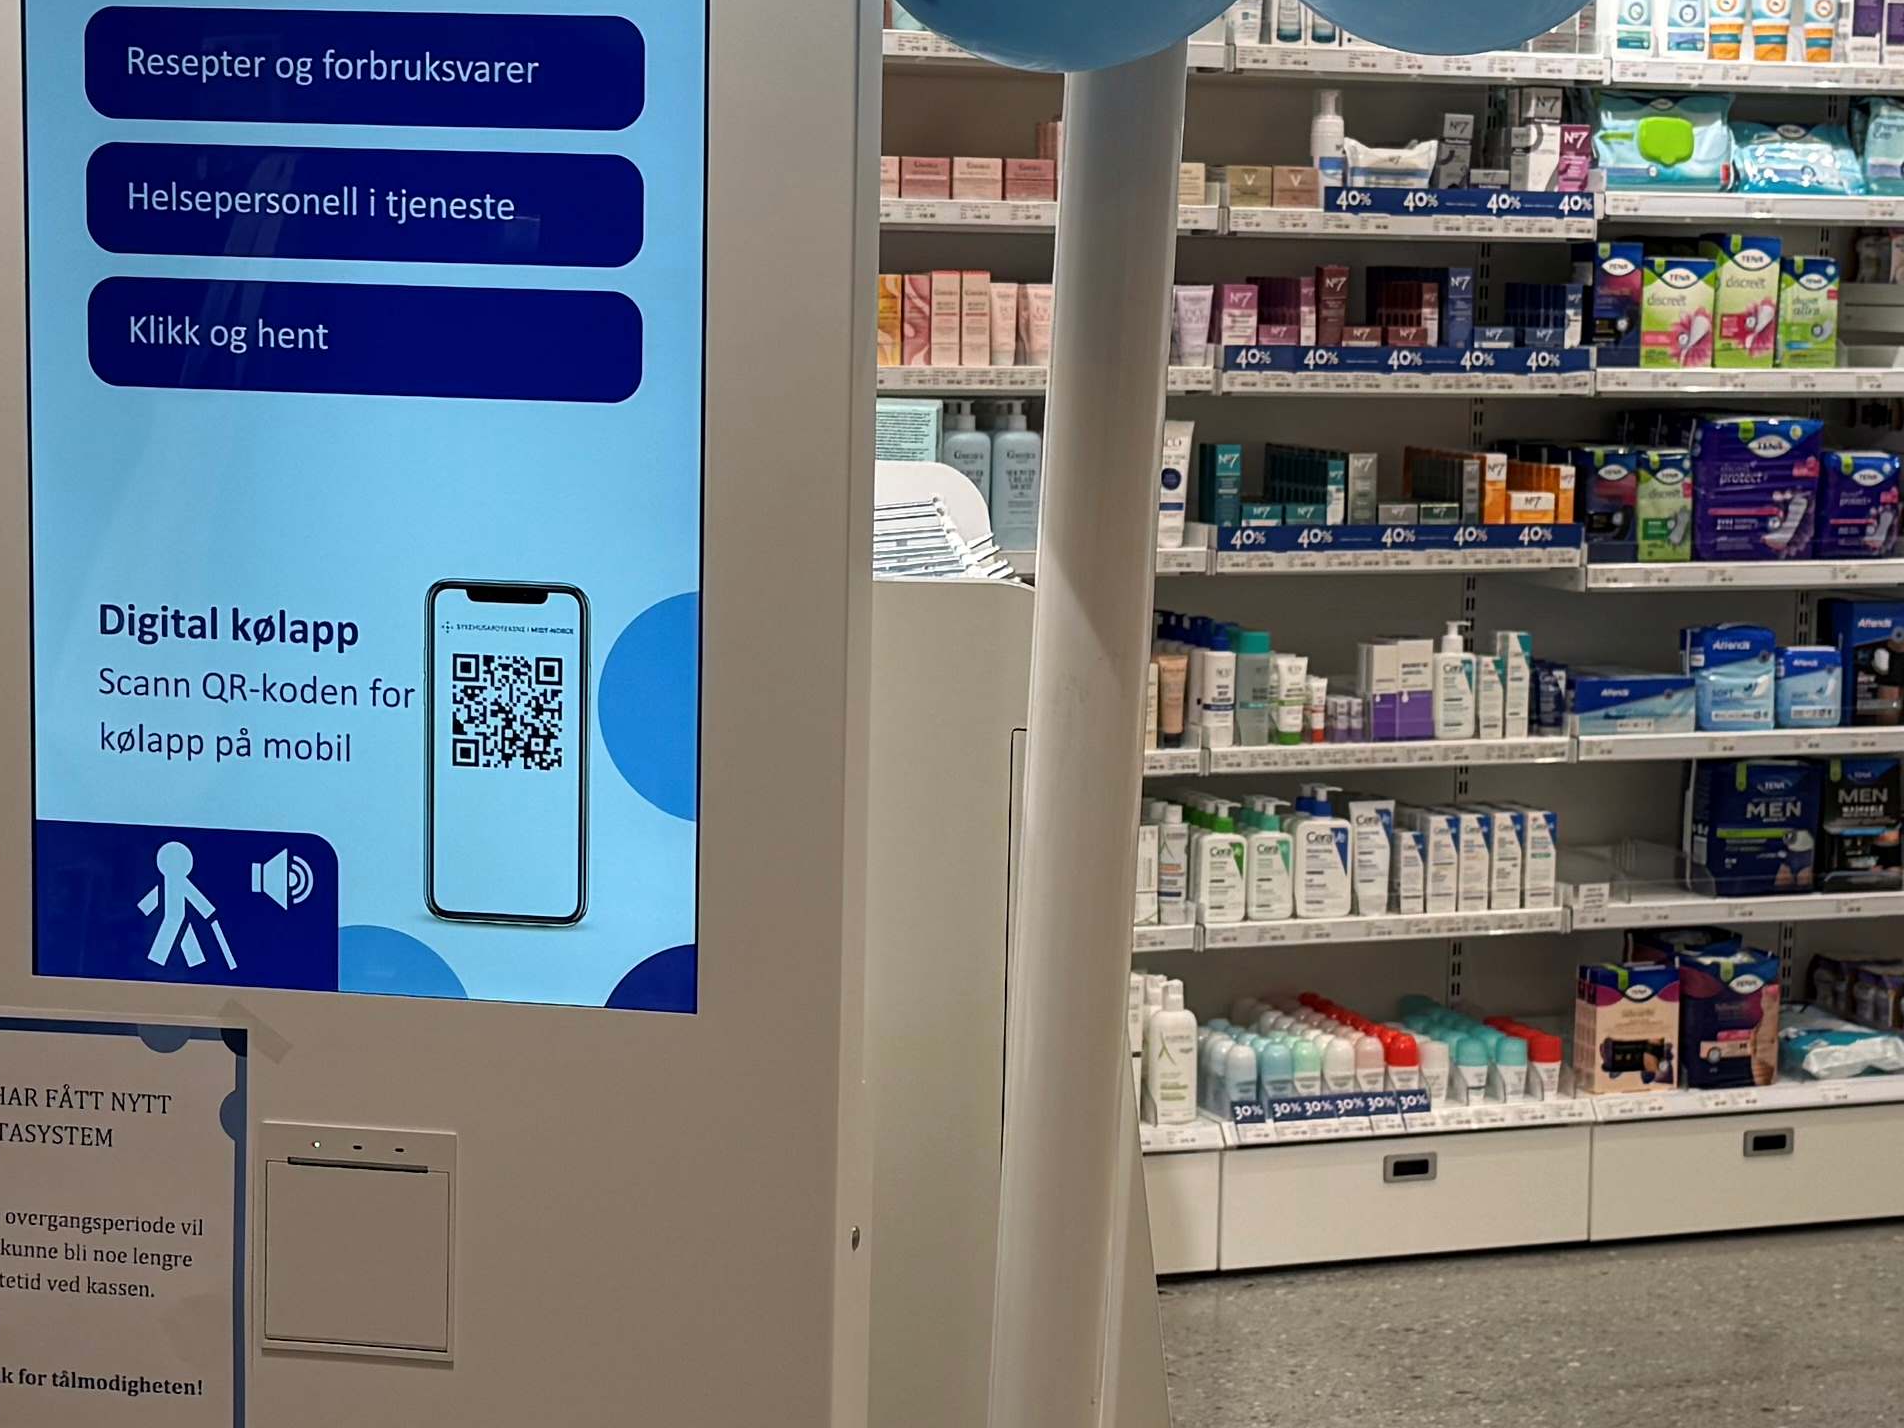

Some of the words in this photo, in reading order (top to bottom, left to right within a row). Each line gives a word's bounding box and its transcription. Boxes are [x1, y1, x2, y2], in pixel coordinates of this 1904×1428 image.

[126, 46, 265, 80] Resepter
[275, 54, 313, 87] og
[322, 49, 539, 86] forbruksvarer
[128, 182, 359, 224] Helsepersonell
[368, 188, 376, 217] i
[385, 190, 516, 225] tjeneste
[1336, 191, 1371, 208] 40%
[1403, 191, 1438, 208] 40%
[1487, 193, 1521, 211] 40%
[1558, 194, 1593, 212] 40%
[129, 316, 200, 347] Klikk
[209, 323, 247, 355] og
[258, 319, 329, 351] hent
[1236, 349, 1271, 367] 40%
[1304, 349, 1339, 370] 40%
[1388, 349, 1422, 368] 40%
[1460, 350, 1495, 368] 40%
[1526, 350, 1560, 369] 40%
[1231, 530, 1266, 550] 40%
[1298, 528, 1332, 547] 40%
[99, 603, 219, 643] Digital
[232, 607, 359, 651] kølapp
[98, 668, 190, 699] Scann
[202, 671, 358, 708] QR-koden
[368, 678, 416, 708] for
[100, 723, 204, 760] kølapp
[215, 727, 252, 762] på
[264, 731, 351, 762] mobil
[1838, 788, 1887, 803] MEN
[1746, 802, 1801, 818] MEN
[45, 1084, 104, 1112] FÅTT
[110, 1091, 172, 1115] NYTT
[1272, 1102, 1301, 1116] 30%
[1303, 1100, 1332, 1114] 30%
[1336, 1097, 1364, 1112] 30%
[1234, 1104, 1263, 1119] 30%
[5, 1208, 175, 1236] overgangsperiode
[181, 1217, 203, 1237] vil
[0, 1239, 58, 1259] kunne
[64, 1243, 88, 1261] bli
[93, 1248, 127, 1263] noe
[132, 1248, 192, 1271] lengre
[47, 1275, 80, 1293] ved
[86, 1276, 155, 1298] kassen.
[19, 1369, 47, 1387] for
[52, 1370, 203, 1397] tålmodigheten!
